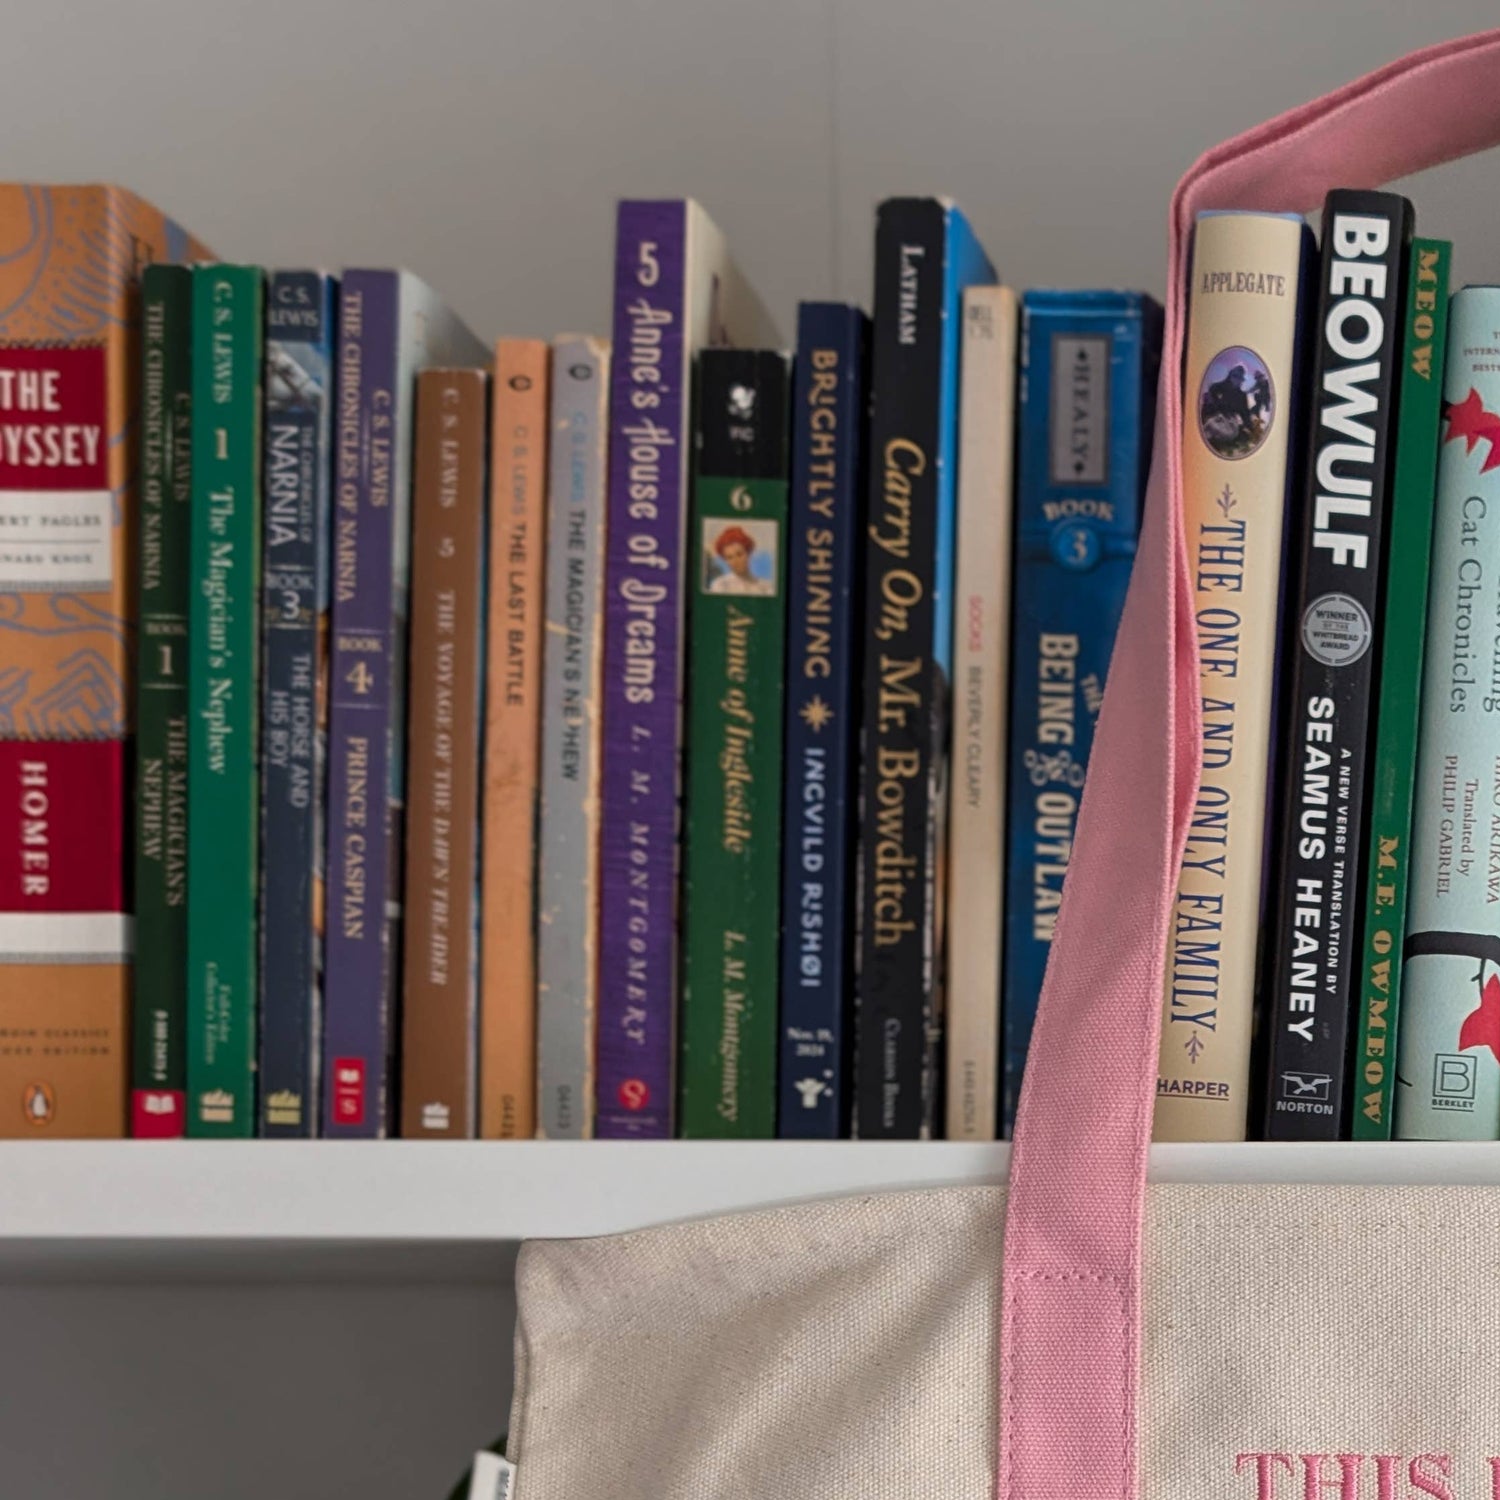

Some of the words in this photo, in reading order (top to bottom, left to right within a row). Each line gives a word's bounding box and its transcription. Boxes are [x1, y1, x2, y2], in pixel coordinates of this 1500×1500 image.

[638, 242, 660, 287] 5
[1201, 272, 1285, 296] APPLEGATE
[147, 302, 164, 344] THE
[343, 293, 361, 336] THE
[1410, 249, 1439, 381] MEOW
[0, 369, 61, 411] THE
[214, 333, 232, 403] LEWIS
[627, 300, 672, 409] Anne's
[1312, 215, 1390, 569] BEOWULF
[145, 348, 163, 473] CHRONICLES
[340, 343, 361, 478] CHRONICLES
[808, 350, 838, 517] BRIGHTLY
[270, 425, 297, 545] NARNIA
[371, 439, 389, 506] LEWIS
[441, 440, 458, 507] LEWIS
[623, 418, 675, 519] House
[730, 486, 752, 511] 6
[869, 439, 925, 558] Carry
[210, 487, 233, 535] The
[509, 523, 526, 563] THE
[568, 510, 586, 550] THE
[1461, 496, 1486, 547] Cat
[143, 515, 161, 589] NARNIA
[337, 521, 357, 601] NARNIA
[628, 536, 668, 568] of
[1197, 520, 1246, 592] THE
[202, 542, 232, 668] Magician's
[437, 590, 455, 634] THE
[508, 571, 525, 621] LAST
[806, 528, 834, 678] SHINING
[293, 656, 309, 689] THE
[506, 630, 525, 705] BATTLE
[621, 580, 666, 703] Dreams
[724, 606, 753, 681] Anne
[1450, 558, 1482, 714] Chronicles
[201, 679, 232, 774] Nephew
[272, 692, 288, 723] HIS
[292, 697, 309, 758] HORSE
[878, 655, 921, 733] Mr.
[1039, 634, 1078, 744] BEING
[168, 716, 185, 763] THE
[271, 729, 288, 767] BOY
[1298, 696, 1334, 860] SEAMUS
[142, 760, 161, 859] NEPHEW
[292, 765, 308, 808] AND
[345, 737, 368, 825] PRINCE
[723, 725, 750, 853] Ingleside
[802, 748, 825, 871] INGVILD
[1441, 755, 1458, 813] PHILIP
[1460, 779, 1479, 853] Translated
[20, 760, 49, 895] HOMER
[167, 770, 184, 906] MAGICIAN'S
[873, 746, 920, 946] Bowditch
[1334, 806, 1349, 854] VERSE
[1436, 819, 1453, 899] GABRIEL
[343, 835, 366, 939] CASPIAN
[1326, 861, 1344, 968] TRANSLATION
[622, 823, 649, 1044] MONTGOMERY
[1170, 894, 1223, 1032] FAMILY
[1287, 878, 1323, 1042] HEANEY
[718, 989, 744, 1121] Montgomery
[1276, 1101, 1333, 1115] NORTON
